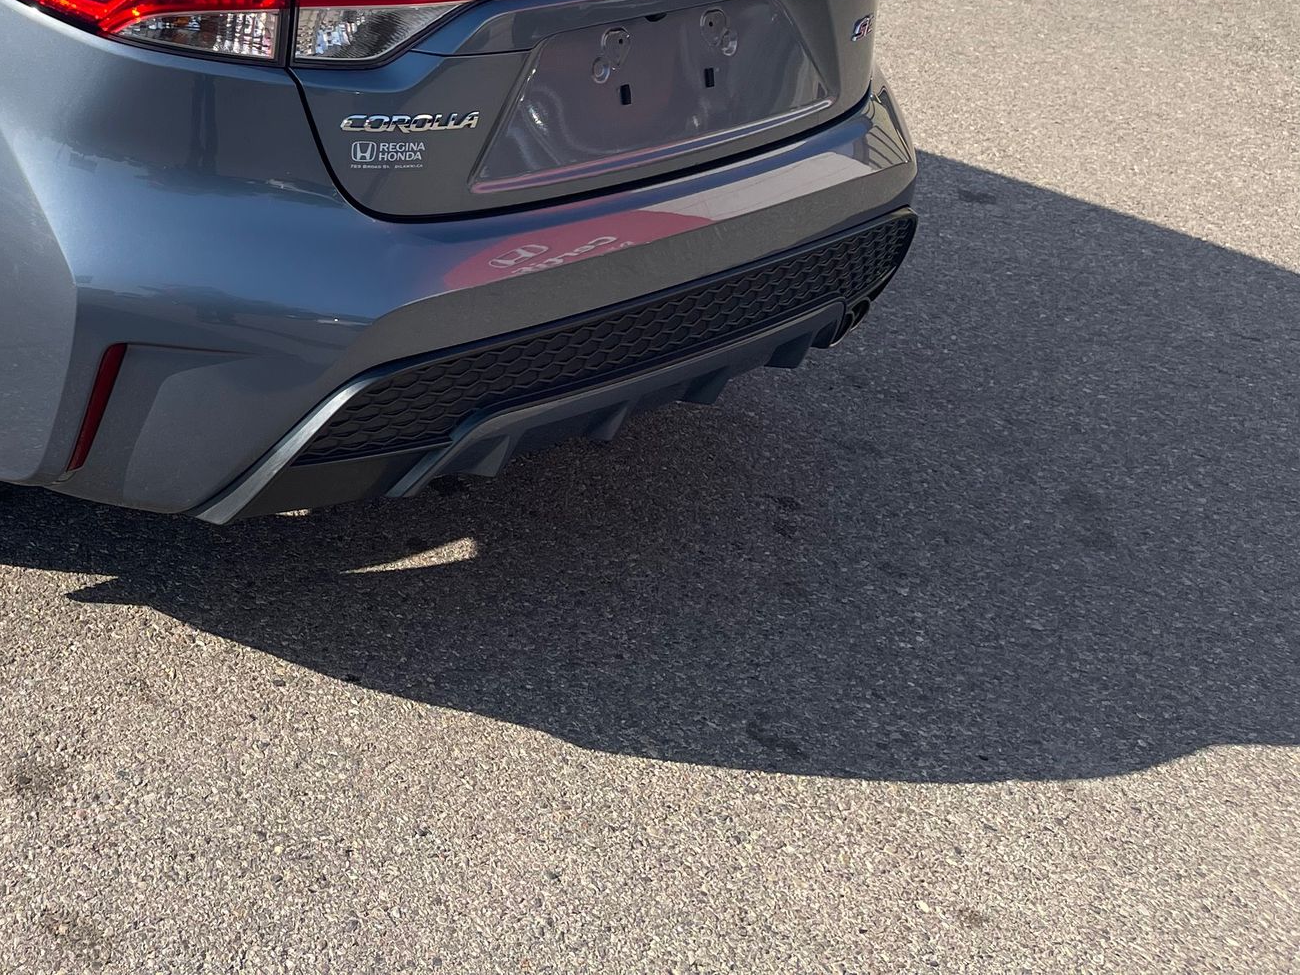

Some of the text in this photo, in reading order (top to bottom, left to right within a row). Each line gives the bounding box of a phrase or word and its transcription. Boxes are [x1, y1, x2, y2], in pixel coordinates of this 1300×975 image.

[340, 111, 480, 133] COROLLA
[379, 142, 426, 152] REGINA
[378, 152, 422, 161] HONDA
